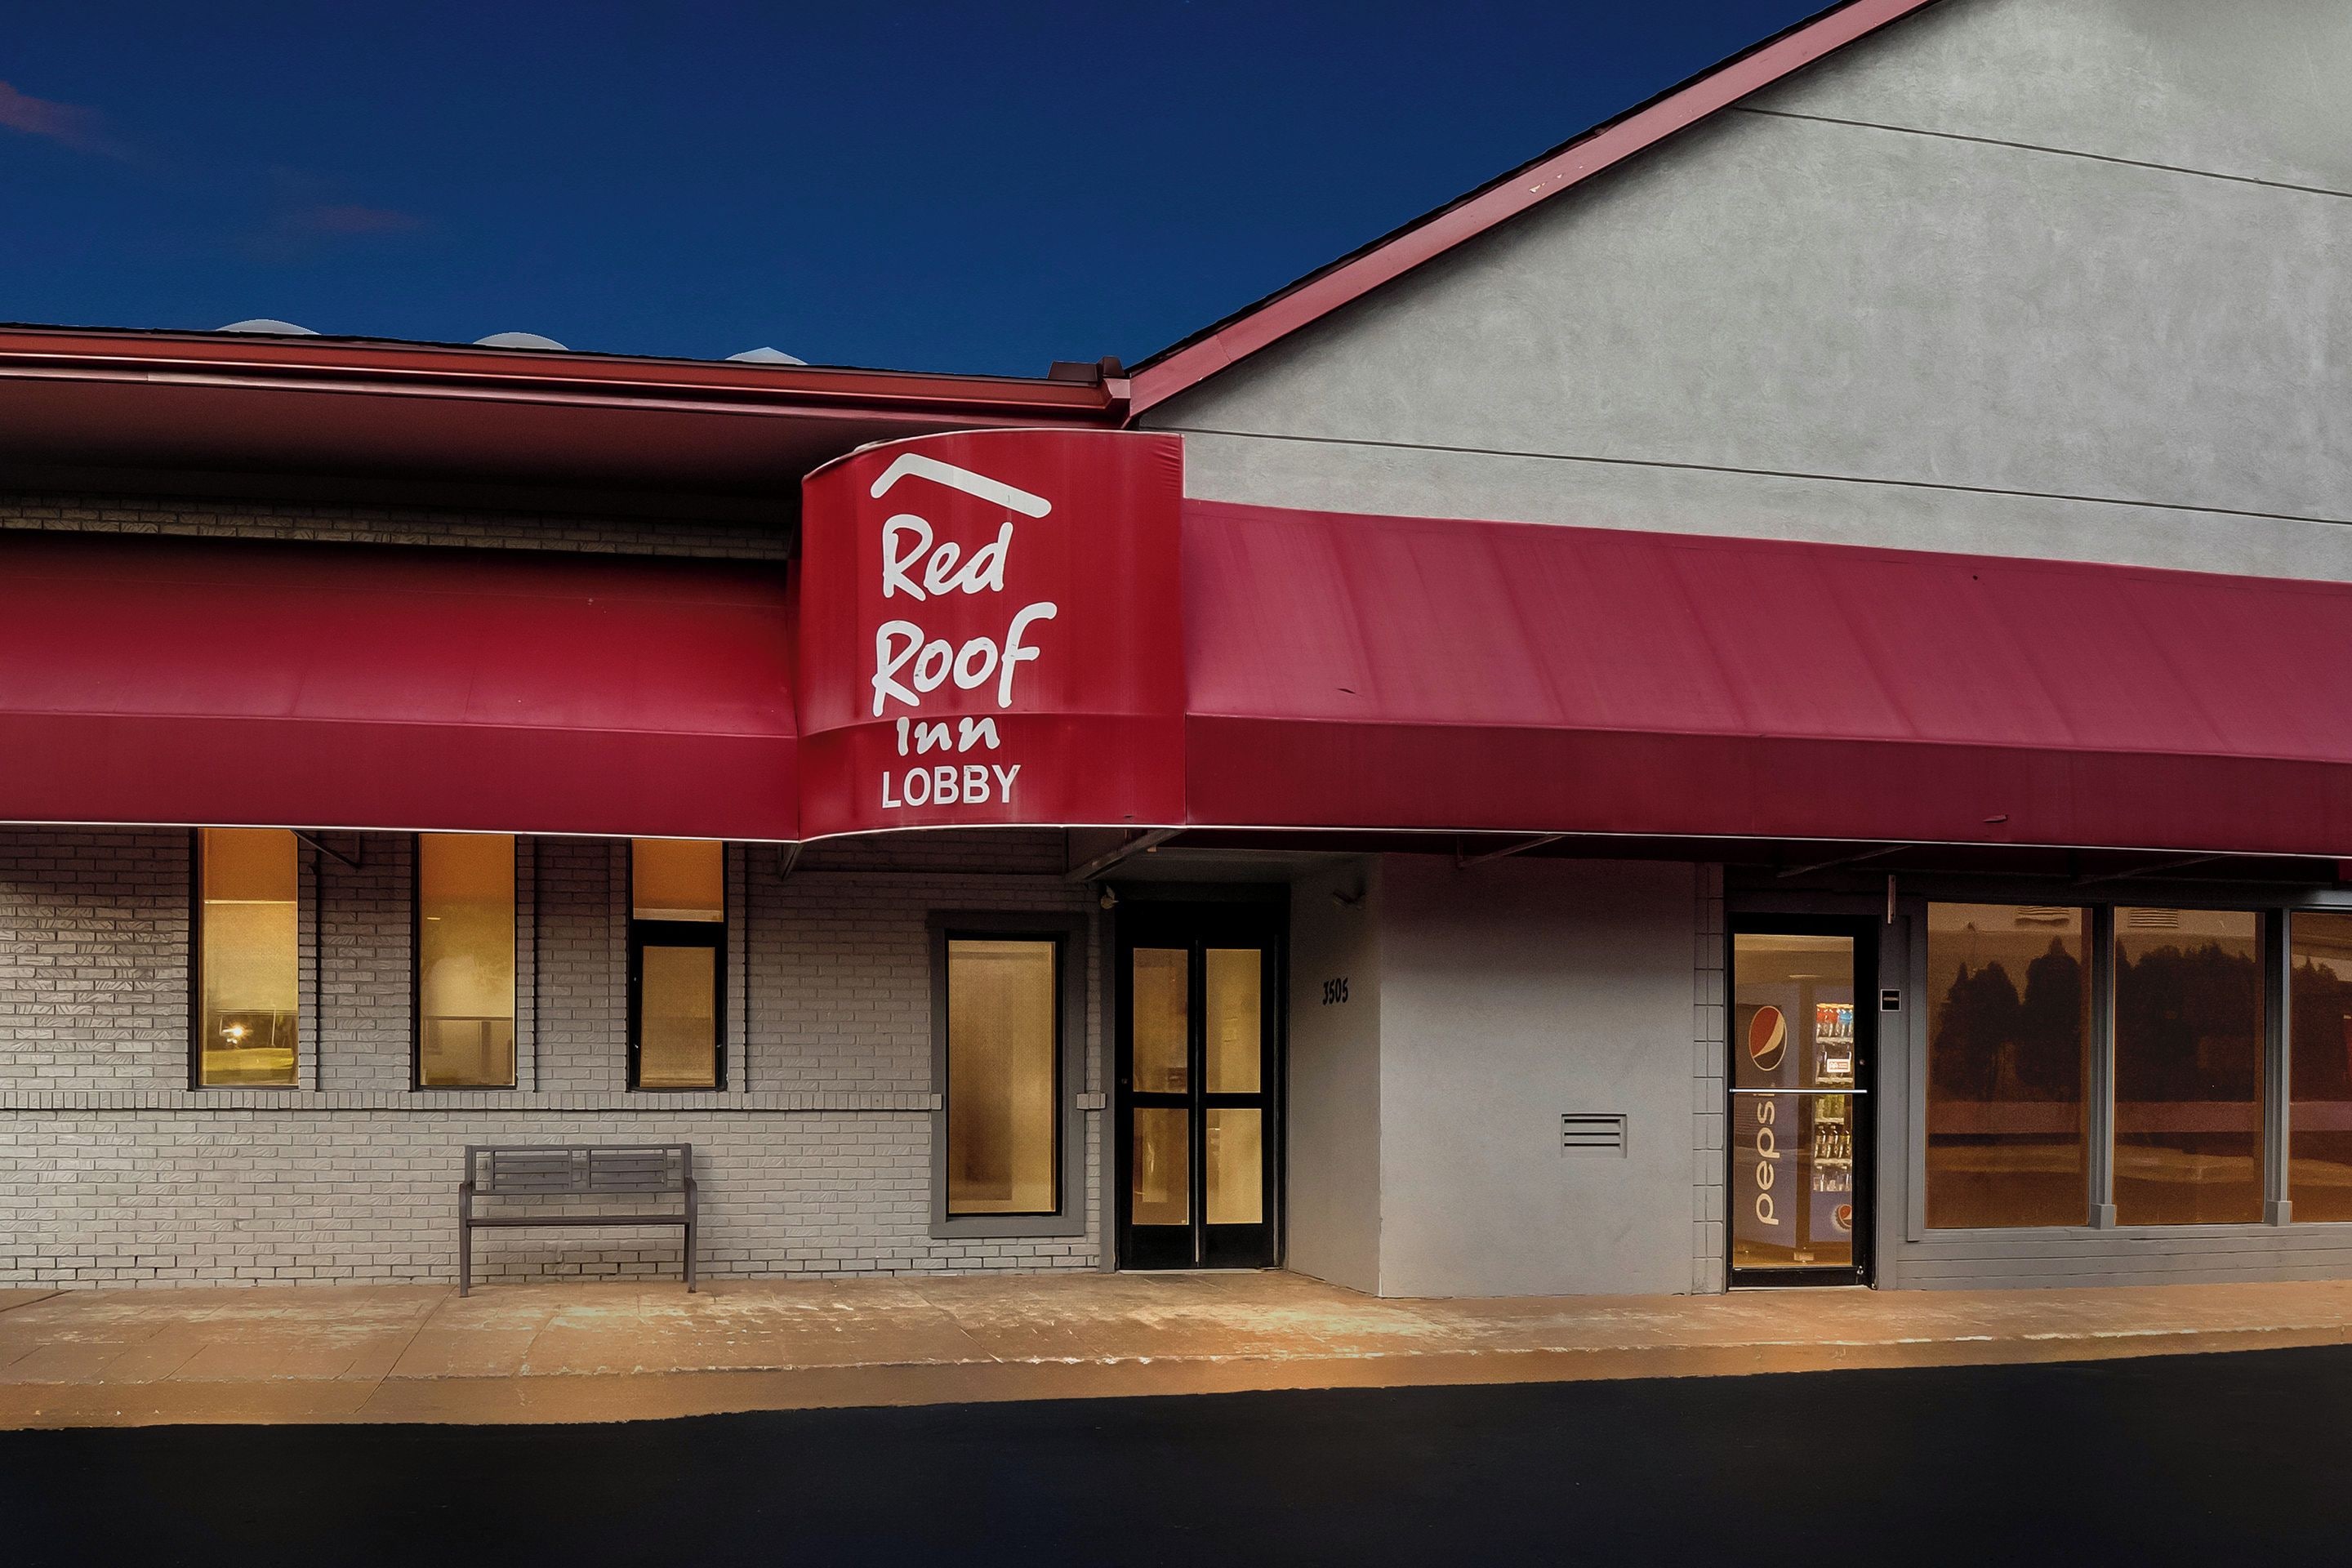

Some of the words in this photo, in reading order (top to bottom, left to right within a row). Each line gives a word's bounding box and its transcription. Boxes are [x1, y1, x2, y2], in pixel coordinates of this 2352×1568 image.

[882, 514, 1013, 601] Red
[871, 602, 1058, 718] Roof
[897, 716, 1000, 756] Inn
[882, 764, 1021, 808] LOBBY
[1323, 978, 1348, 1005] 3505
